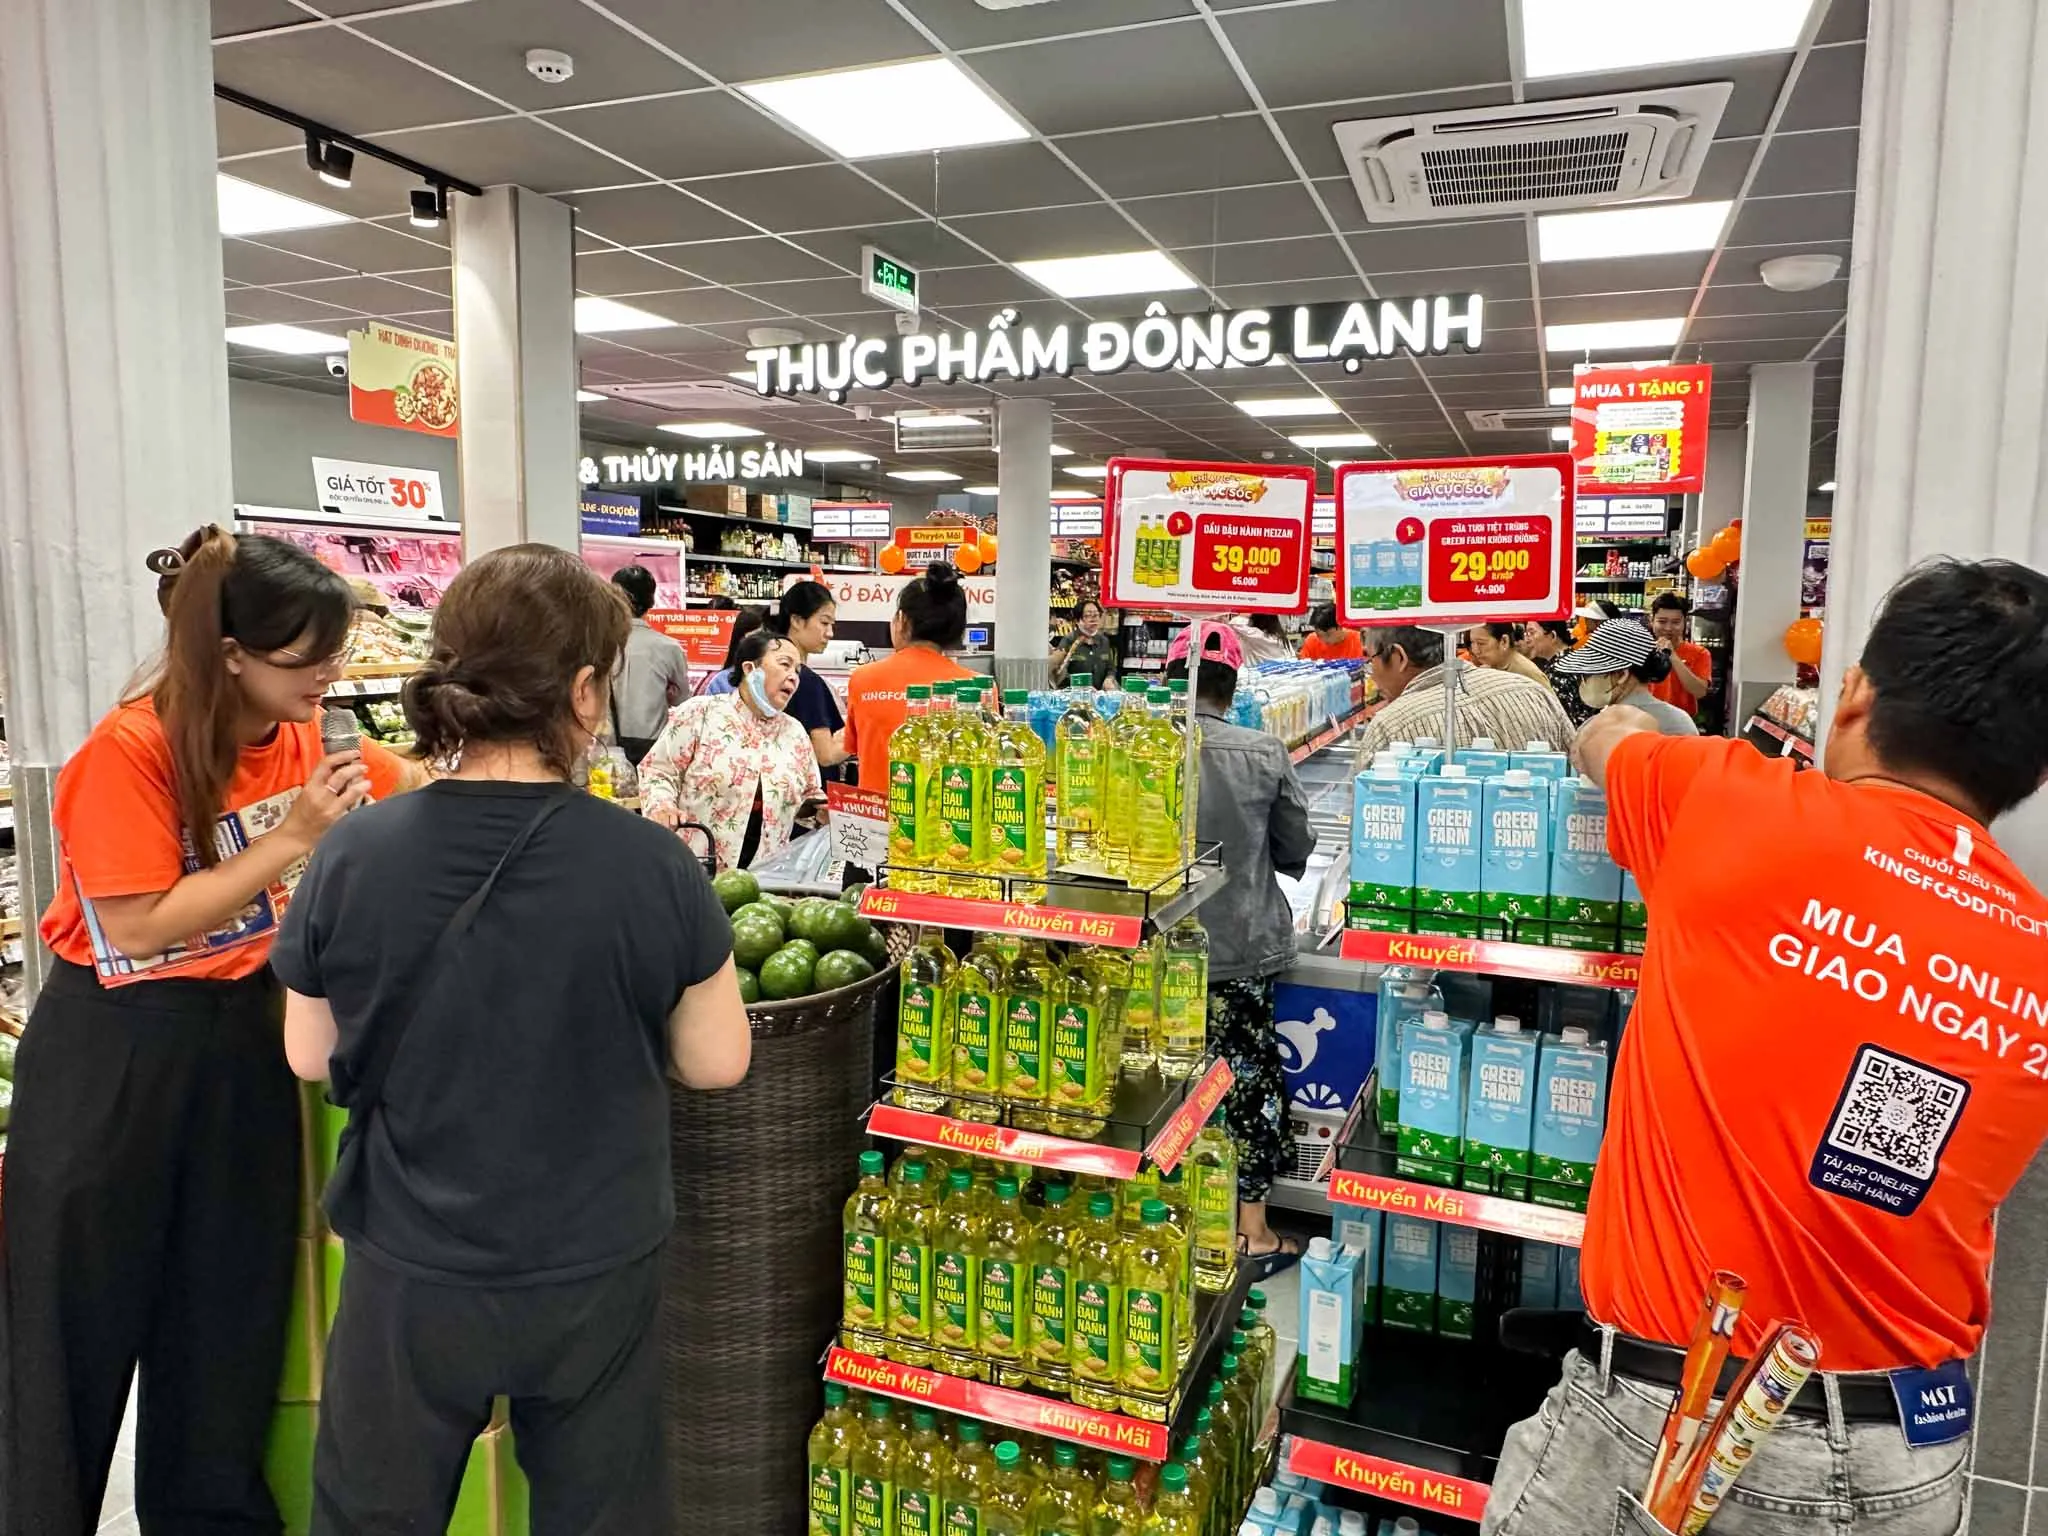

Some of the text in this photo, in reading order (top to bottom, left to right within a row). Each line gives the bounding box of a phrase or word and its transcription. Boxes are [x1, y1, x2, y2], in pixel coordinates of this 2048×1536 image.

[746, 293, 1484, 402] THỰC PHẨM ĐÔNG LẠNH
[1581, 379, 1704, 398] MUA 1 TẶNG 1
[578, 441, 804, 485] & THỦY HẢI SẢN
[327, 474, 355, 492] GIÁ
[357, 475, 386, 495] TỐT
[1434, 484, 1463, 498] CỰC
[1263, 527, 1293, 538] MEIZAN
[1441, 536, 1465, 546] GREEN
[1466, 535, 1486, 545] FARM
[1212, 545, 1281, 573] 39.000
[1450, 550, 1529, 582] 29.000
[840, 584, 853, 601] Ở
[857, 584, 895, 601] ĐÂY
[1232, 576, 1258, 586] 65.000
[1363, 803, 1406, 824] GREEN
[1428, 808, 1473, 828] GREEN
[1493, 810, 1539, 830] GREEN
[1566, 814, 1606, 834] GREE
[1364, 821, 1403, 841] FARM
[1429, 827, 1470, 846] FARM
[1495, 828, 1536, 849] FARM
[1904, 847, 2017, 908] CHUỖI SIÊU THỊ
[866, 891, 898, 913] Mãi
[1004, 908, 1116, 938] Khuyến Mãi
[1388, 939, 1473, 965] Khuyến
[1801, 898, 2048, 1028] MUA ONLIN
[1768, 933, 1889, 1002] GIAO
[1898, 985, 2020, 1058] NGAY
[1408, 1050, 1451, 1073] GREEN
[1410, 1068, 1448, 1091] FARM
[1480, 1063, 1525, 1087] GREEN
[1480, 1081, 1522, 1105] FARM
[1550, 1076, 1597, 1099] GREEN
[1551, 1094, 1593, 1117] FARM
[938, 1123, 1003, 1151] Khuyến
[1822, 1153, 1921, 1198] TẢI APP ONELIFE
[1336, 1177, 1464, 1217] Khuyến Mãi
[1822, 1170, 1904, 1207] ĐỂ ĐẶT HÀNG
[832, 1355, 934, 1396] Khuyến Mãi
[1921, 1385, 1957, 1407] MST
[1039, 1404, 1152, 1448] Khuyến Mãi
[1333, 1456, 1464, 1508] Khuyến Mãi
